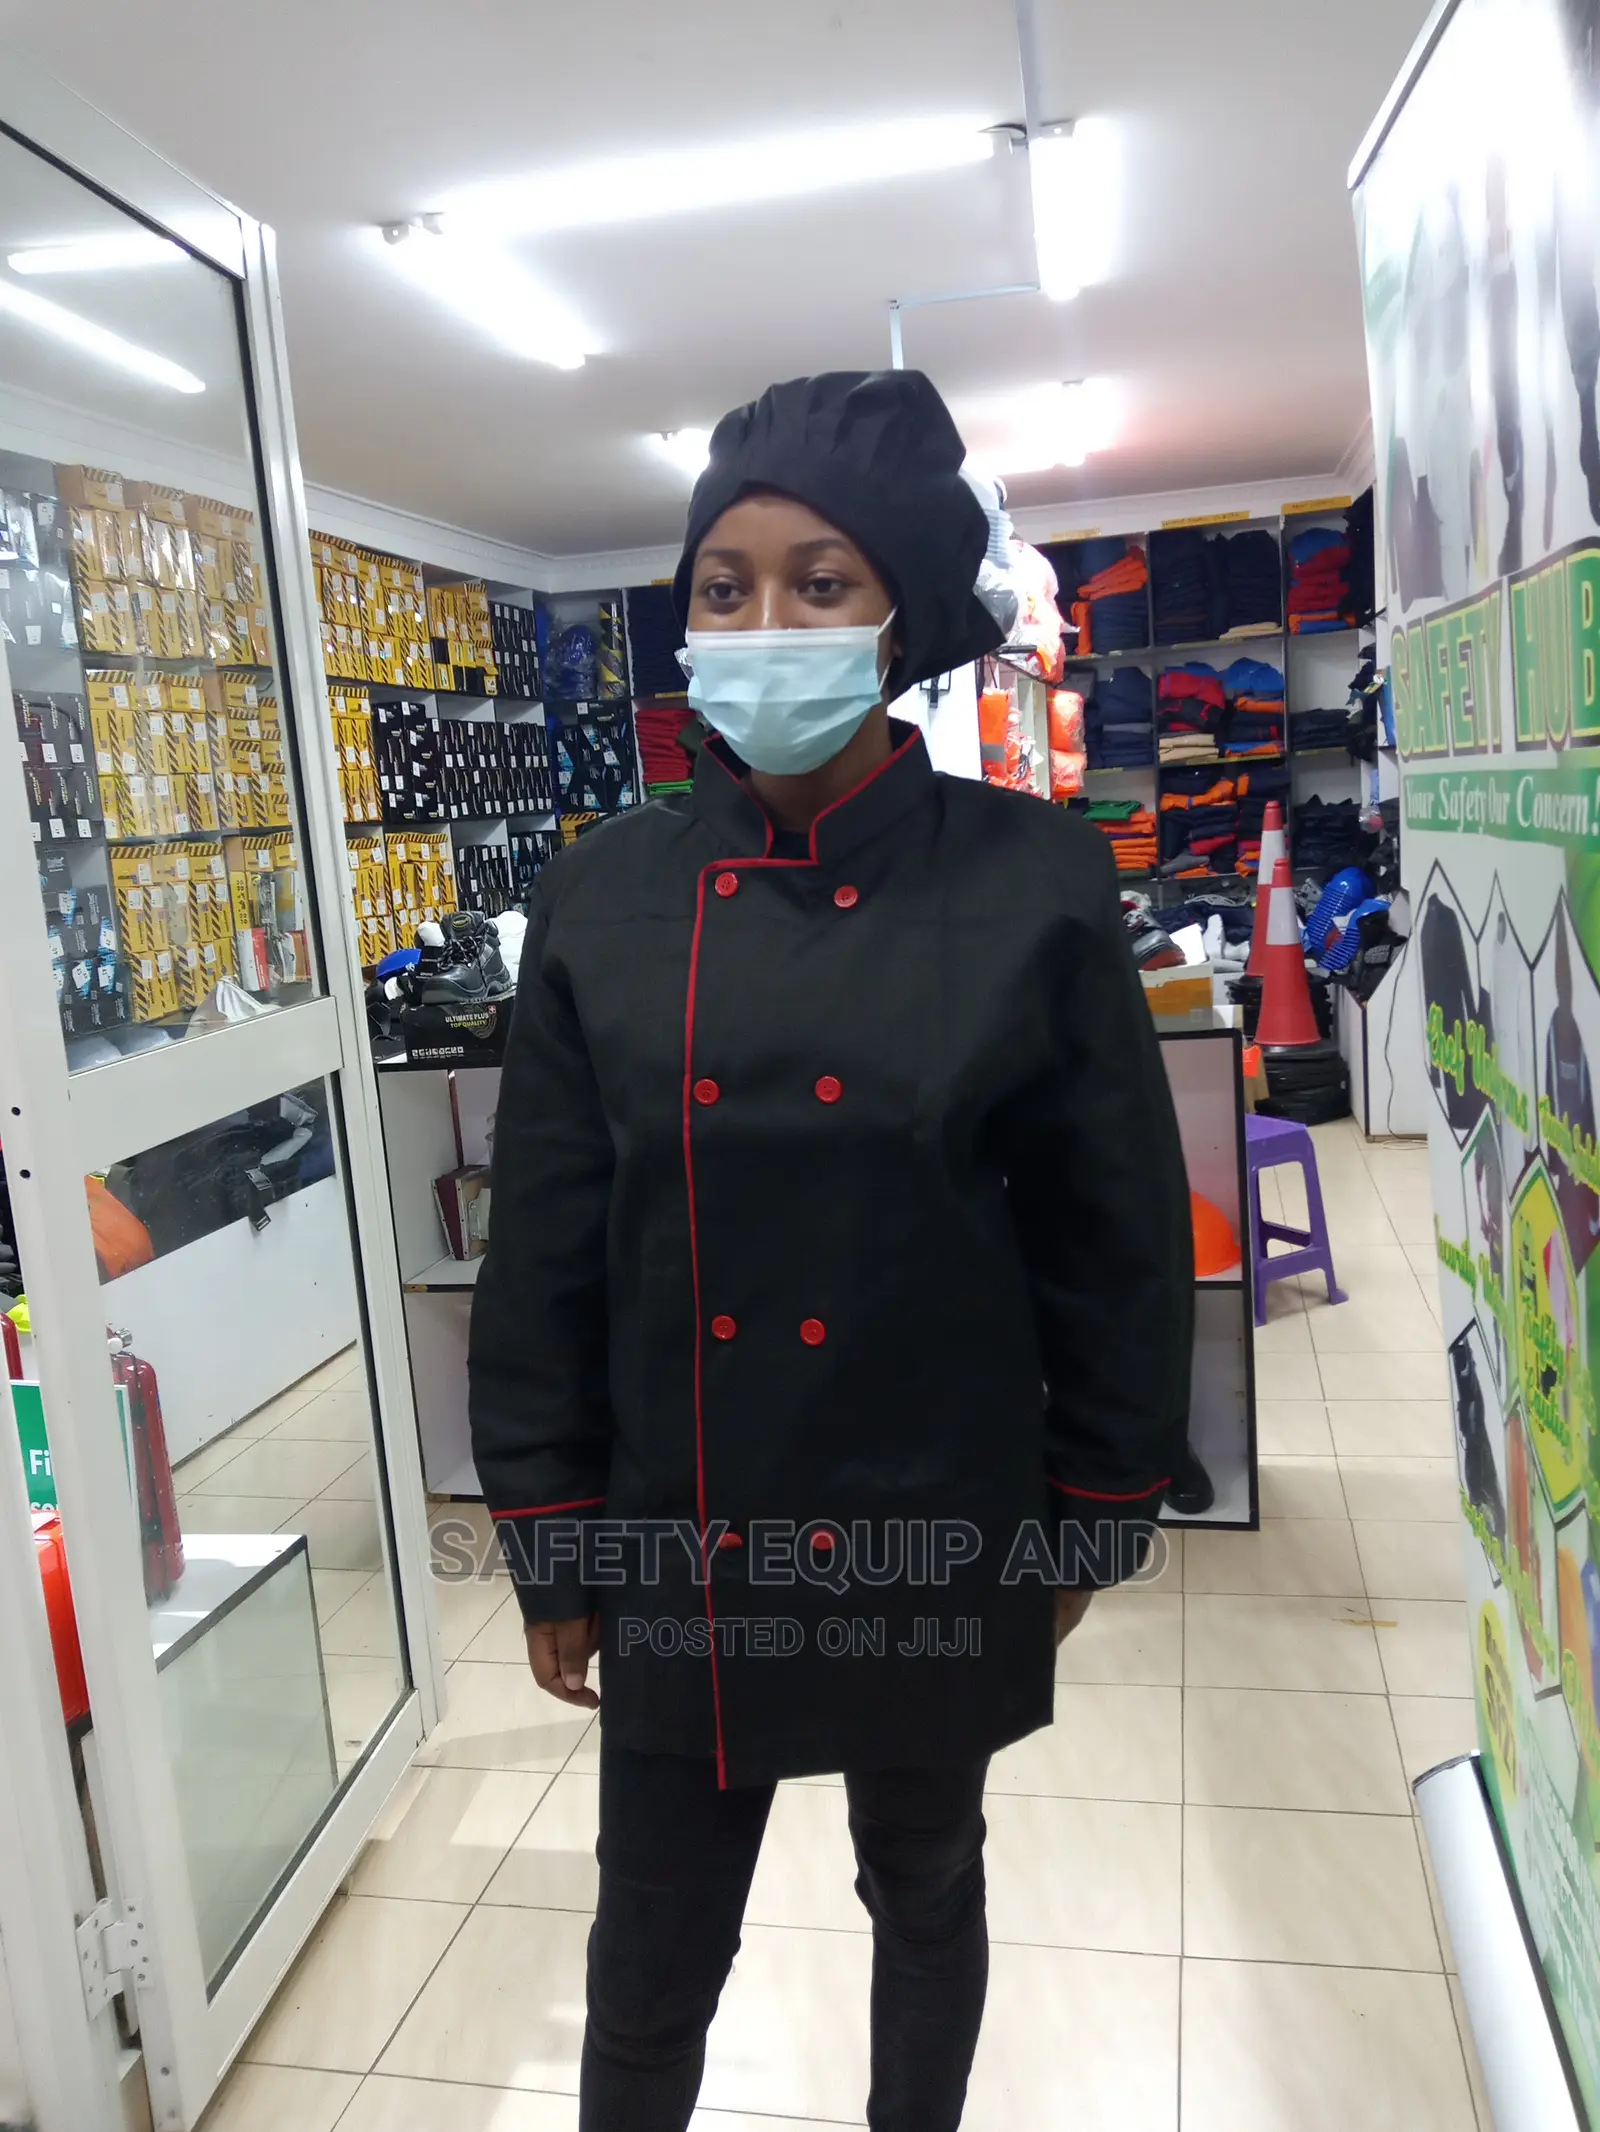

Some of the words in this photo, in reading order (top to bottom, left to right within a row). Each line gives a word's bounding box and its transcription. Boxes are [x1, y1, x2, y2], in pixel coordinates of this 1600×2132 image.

[1391, 587, 1502, 760] SAFETY
[1508, 545, 1600, 752] HUB
[1405, 779, 1435, 822] Your
[1438, 776, 1487, 834] Safety
[445, 1014, 473, 1023] ULTIMATE
[474, 1012, 489, 1020] PLUS
